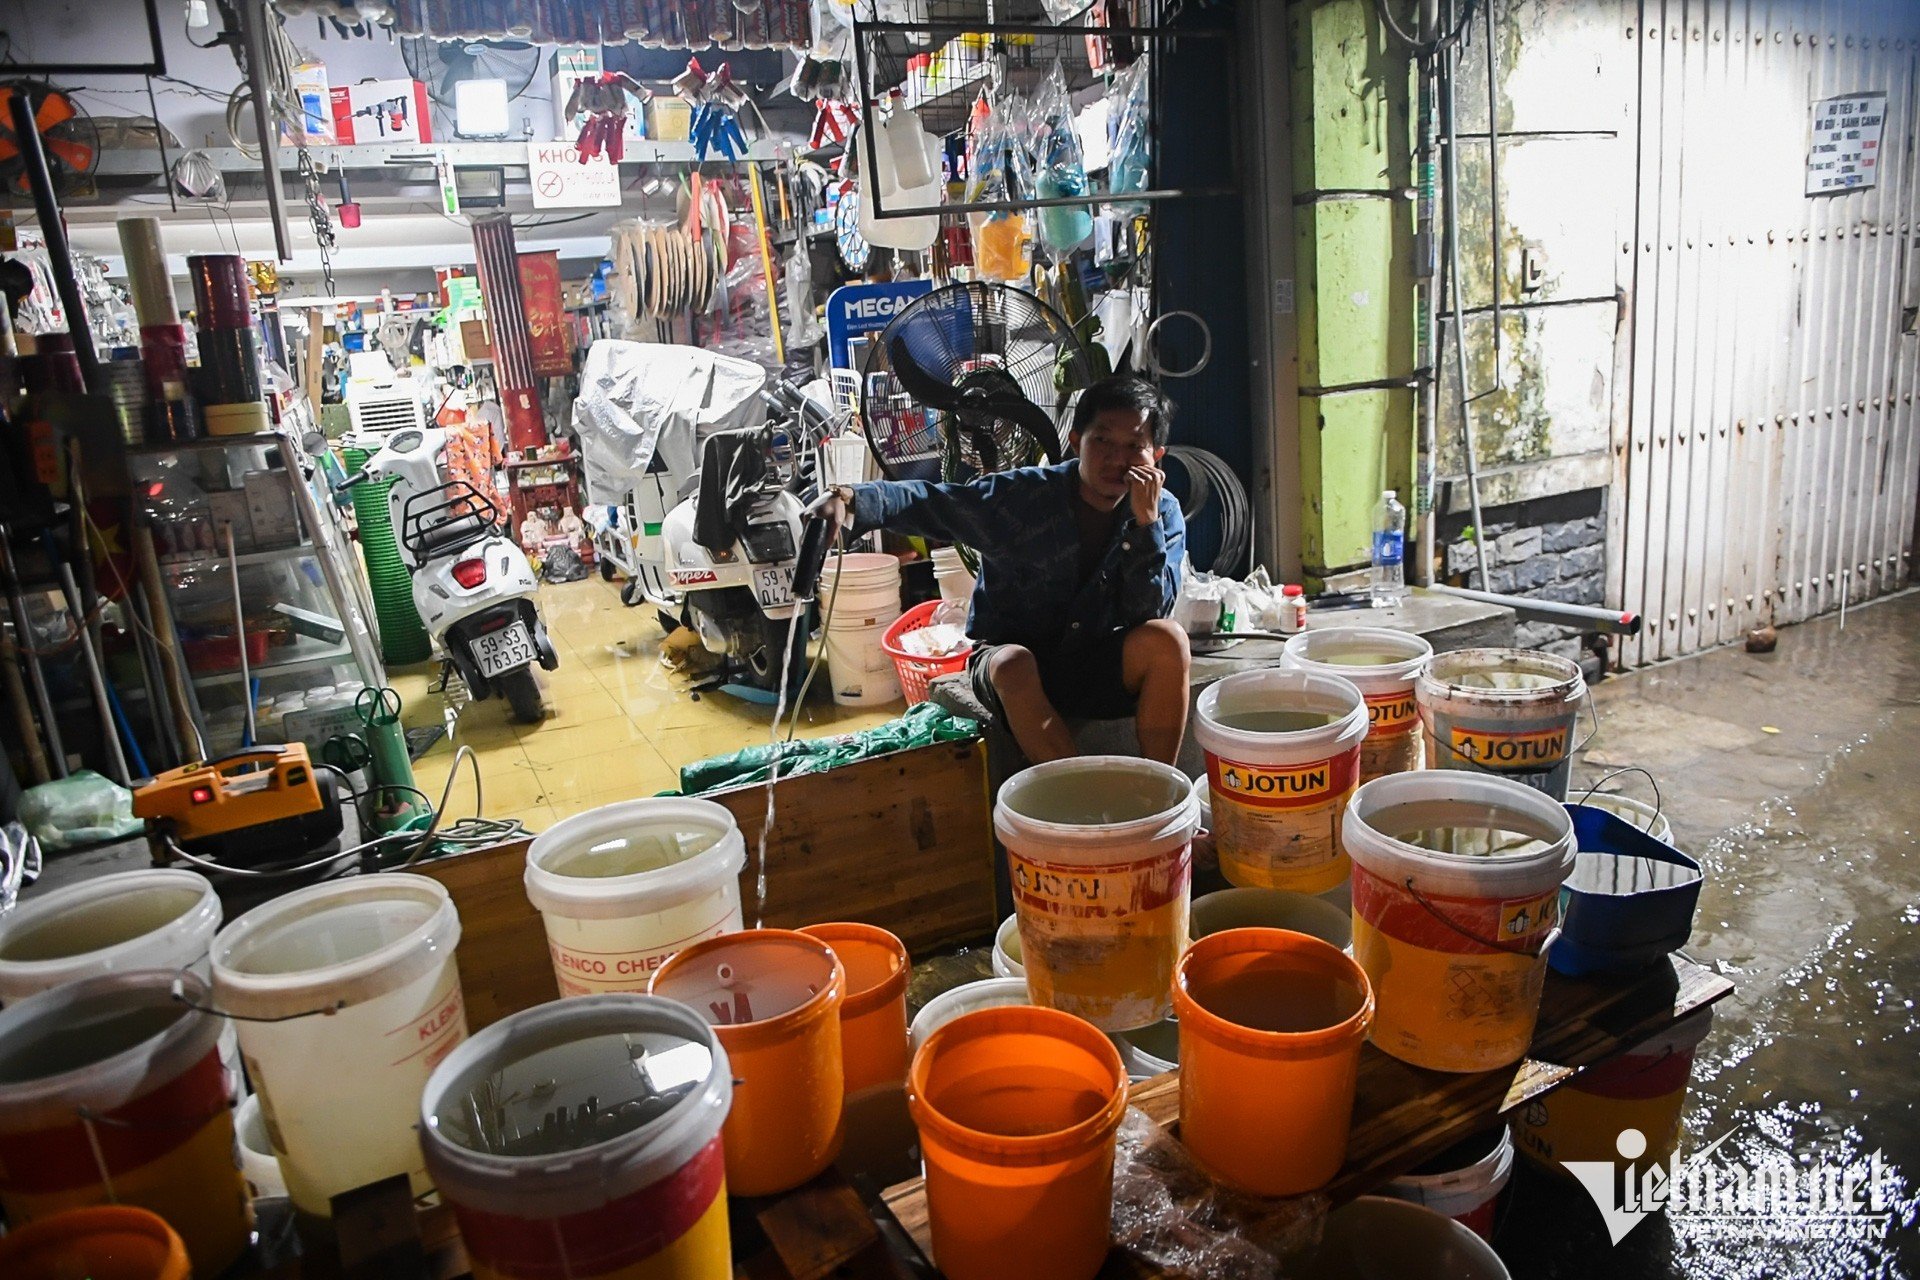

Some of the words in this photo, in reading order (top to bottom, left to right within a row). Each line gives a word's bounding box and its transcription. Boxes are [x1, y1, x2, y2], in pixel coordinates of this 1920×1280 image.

[538, 148, 604, 163] KHO
[668, 570, 713, 585] Super
[762, 566, 796, 587] 59-M
[762, 587, 795, 606] 042.
[480, 628, 521, 655] 59-S3
[482, 643, 533, 674] 763.52
[1367, 702, 1416, 721] OTUN
[1484, 735, 1563, 761] JOTUN
[1244, 770, 1325, 793] JOTUN
[616, 949, 681, 975] CHEM
